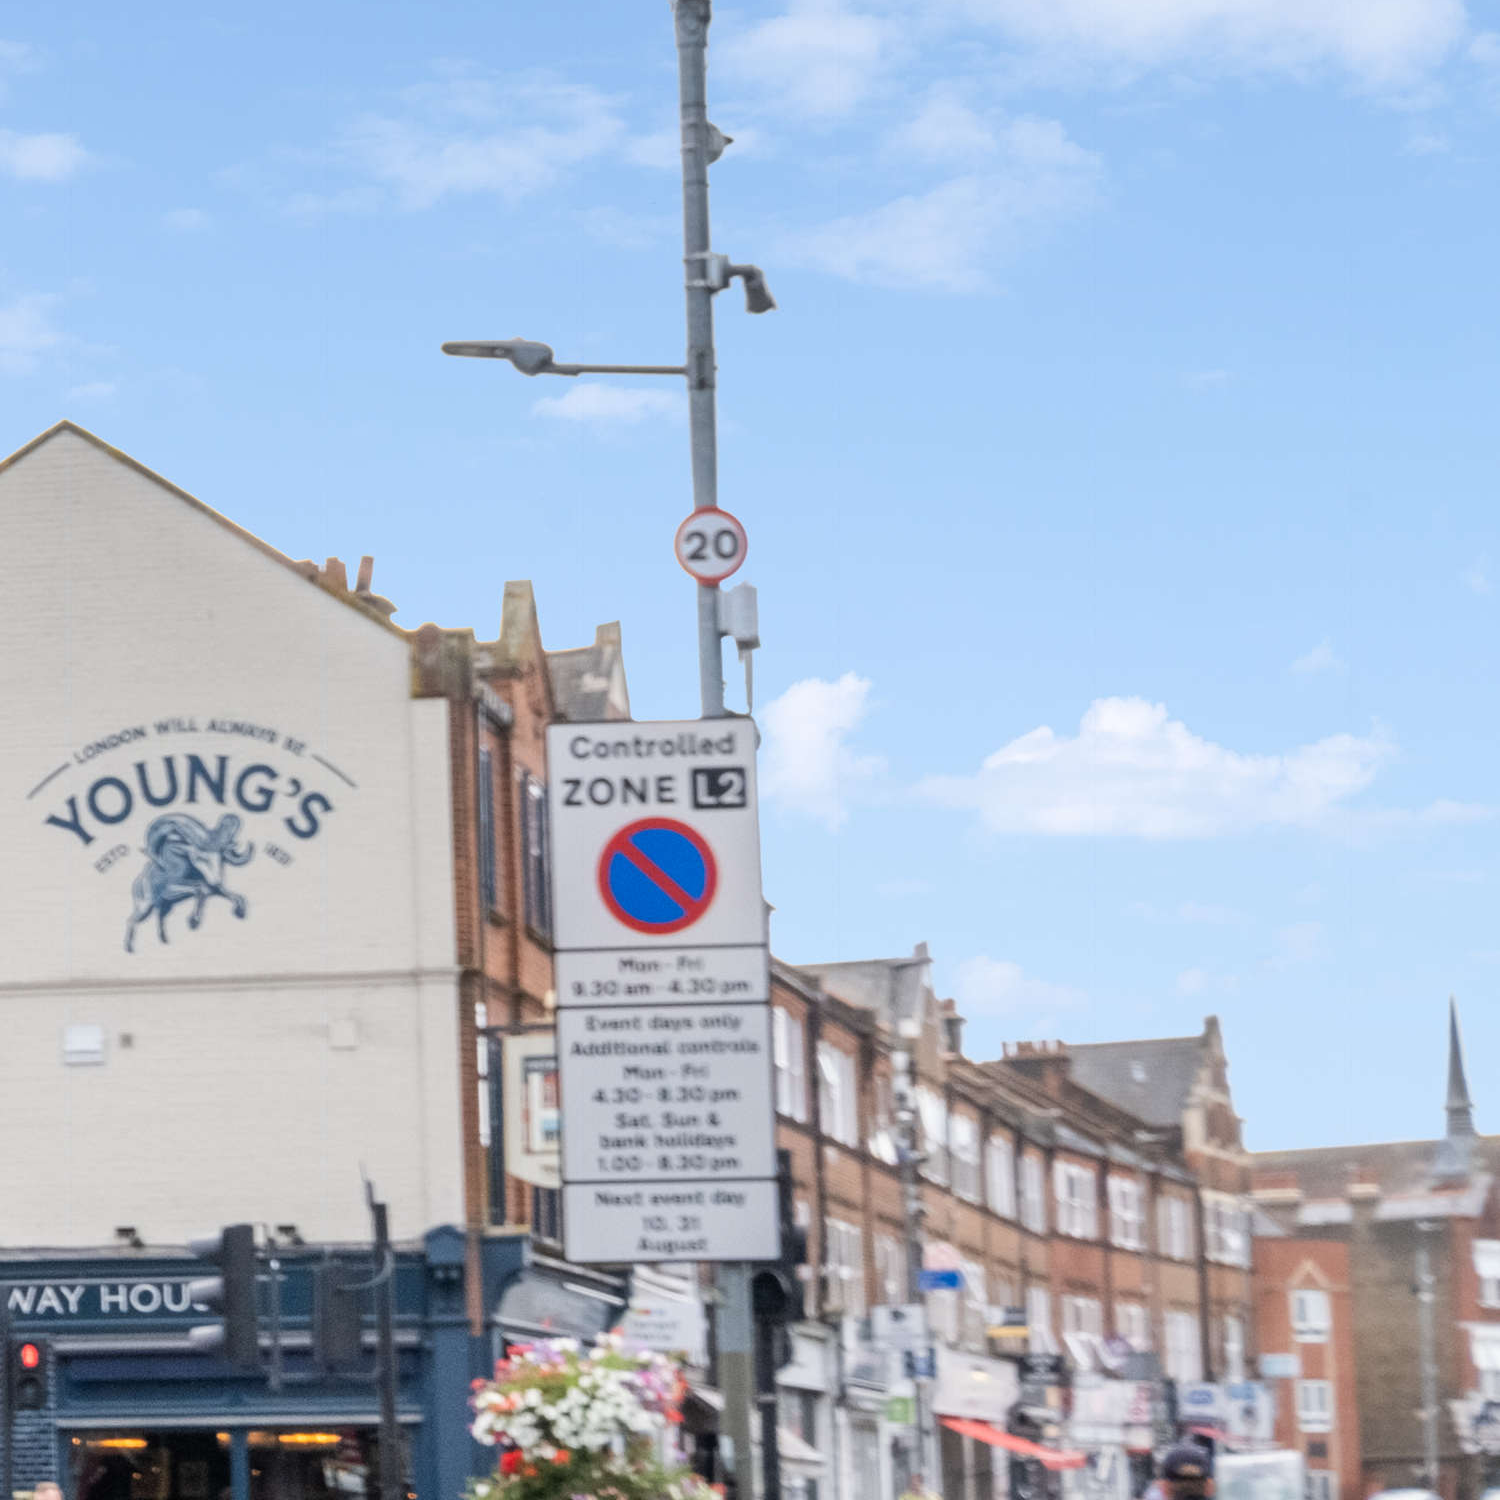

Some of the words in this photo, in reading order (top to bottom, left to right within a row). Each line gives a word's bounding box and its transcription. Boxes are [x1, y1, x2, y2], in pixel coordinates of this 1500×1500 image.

[684, 529, 738, 561] 20
[73, 726, 146, 763] LONDON
[153, 718, 199, 734] WILL
[570, 733, 735, 760] Controlled
[562, 775, 676, 806] ZONE
[695, 771, 745, 806] L2
[44, 753, 334, 846] YOUNG'S
[618, 957, 662, 973] Mon
[585, 1015, 642, 1032] Event
[648, 1015, 694, 1032] days
[700, 1013, 743, 1032] only
[570, 1041, 670, 1057] Additional
[678, 1040, 760, 1056] controls
[623, 1064, 664, 1080] Mon
[661, 1111, 700, 1128] Sun
[598, 1133, 646, 1149] bank
[654, 1132, 737, 1149] holidays
[595, 1191, 642, 1206] Next
[648, 1191, 705, 1206] event
[710, 1189, 746, 1207] day
[637, 1236, 709, 1255] August
